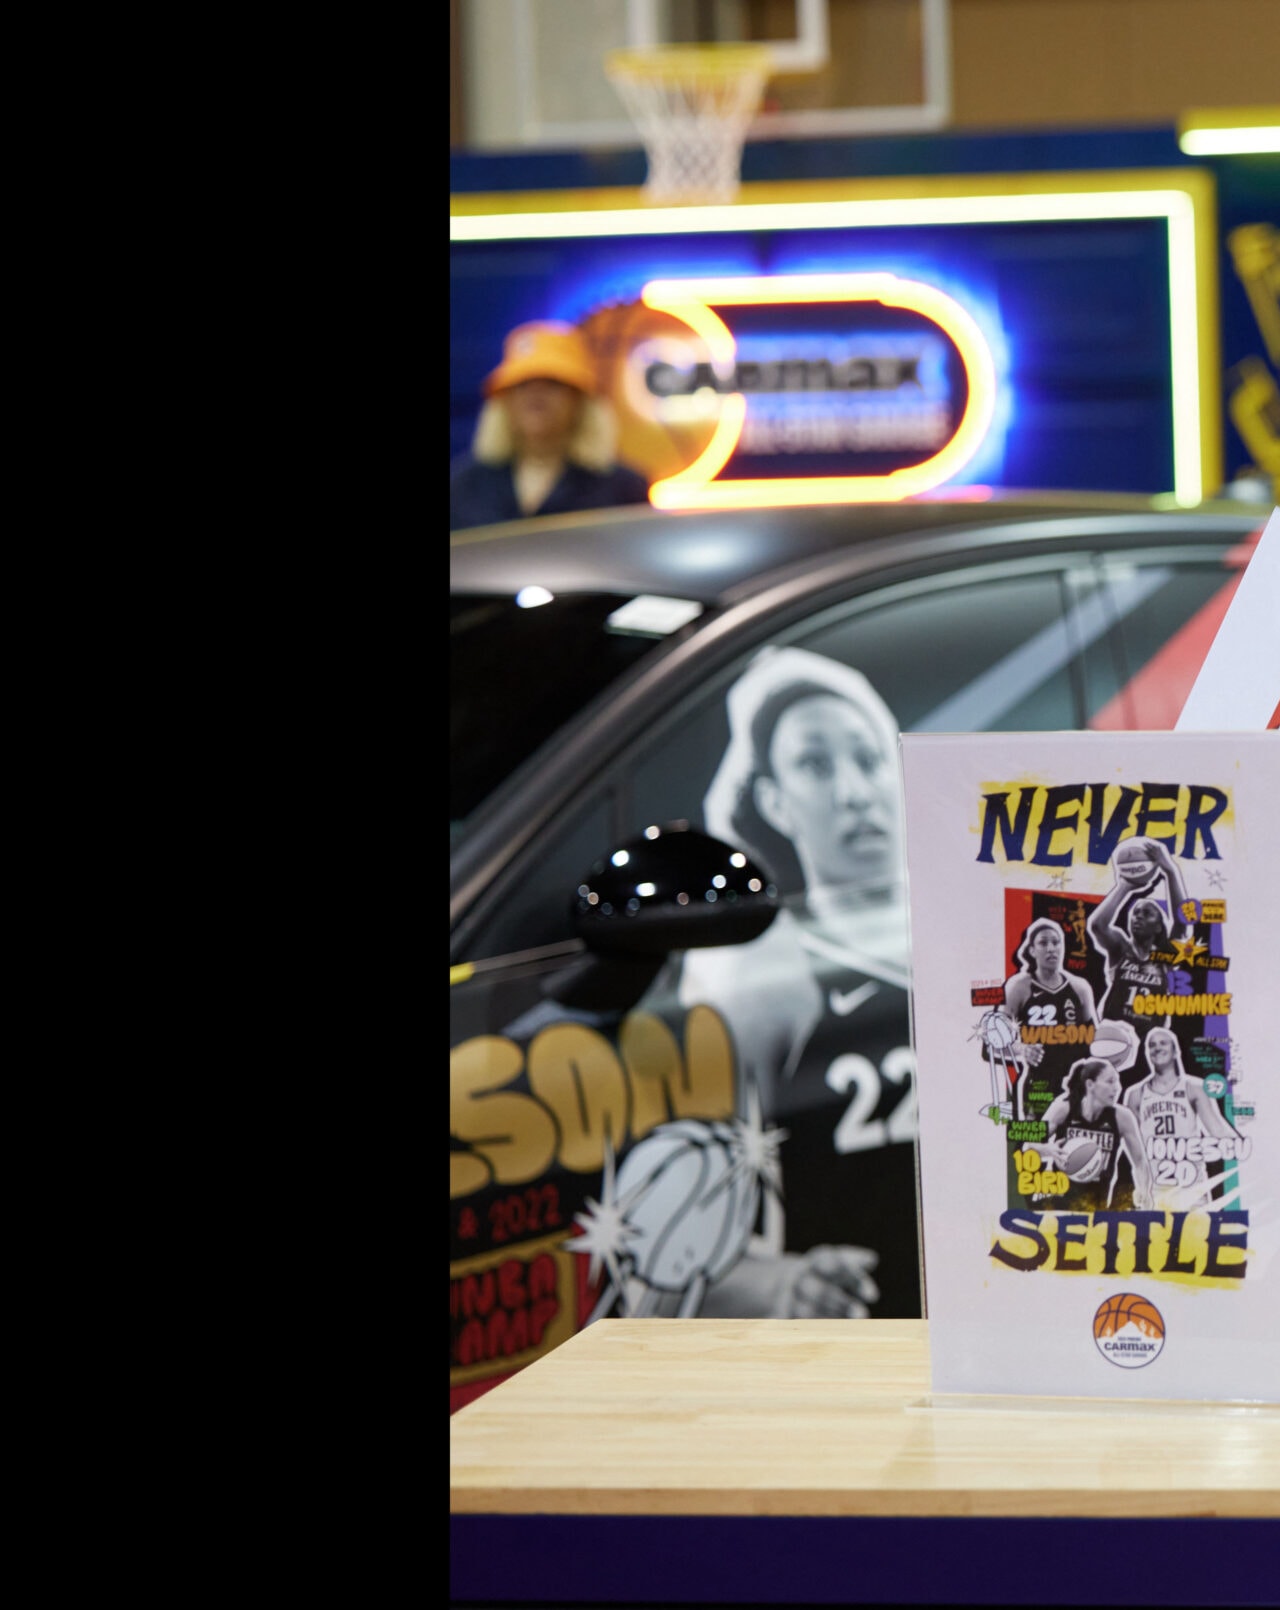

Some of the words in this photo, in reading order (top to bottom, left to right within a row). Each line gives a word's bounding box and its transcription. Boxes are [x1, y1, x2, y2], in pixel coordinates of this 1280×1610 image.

[976, 782, 1229, 867] NEVER
[1027, 1004, 1058, 1026] 22
[1132, 992, 1232, 1016] OGWUMIKE
[1021, 1024, 1095, 1045] WILSON
[826, 1046, 920, 1154] 22
[1007, 1129, 1047, 1142] CHAMP
[1154, 1114, 1175, 1135] 20
[1013, 1150, 1041, 1173] 10
[1018, 1170, 1070, 1195] BIRD
[989, 1208, 1250, 1278] SETTLE
